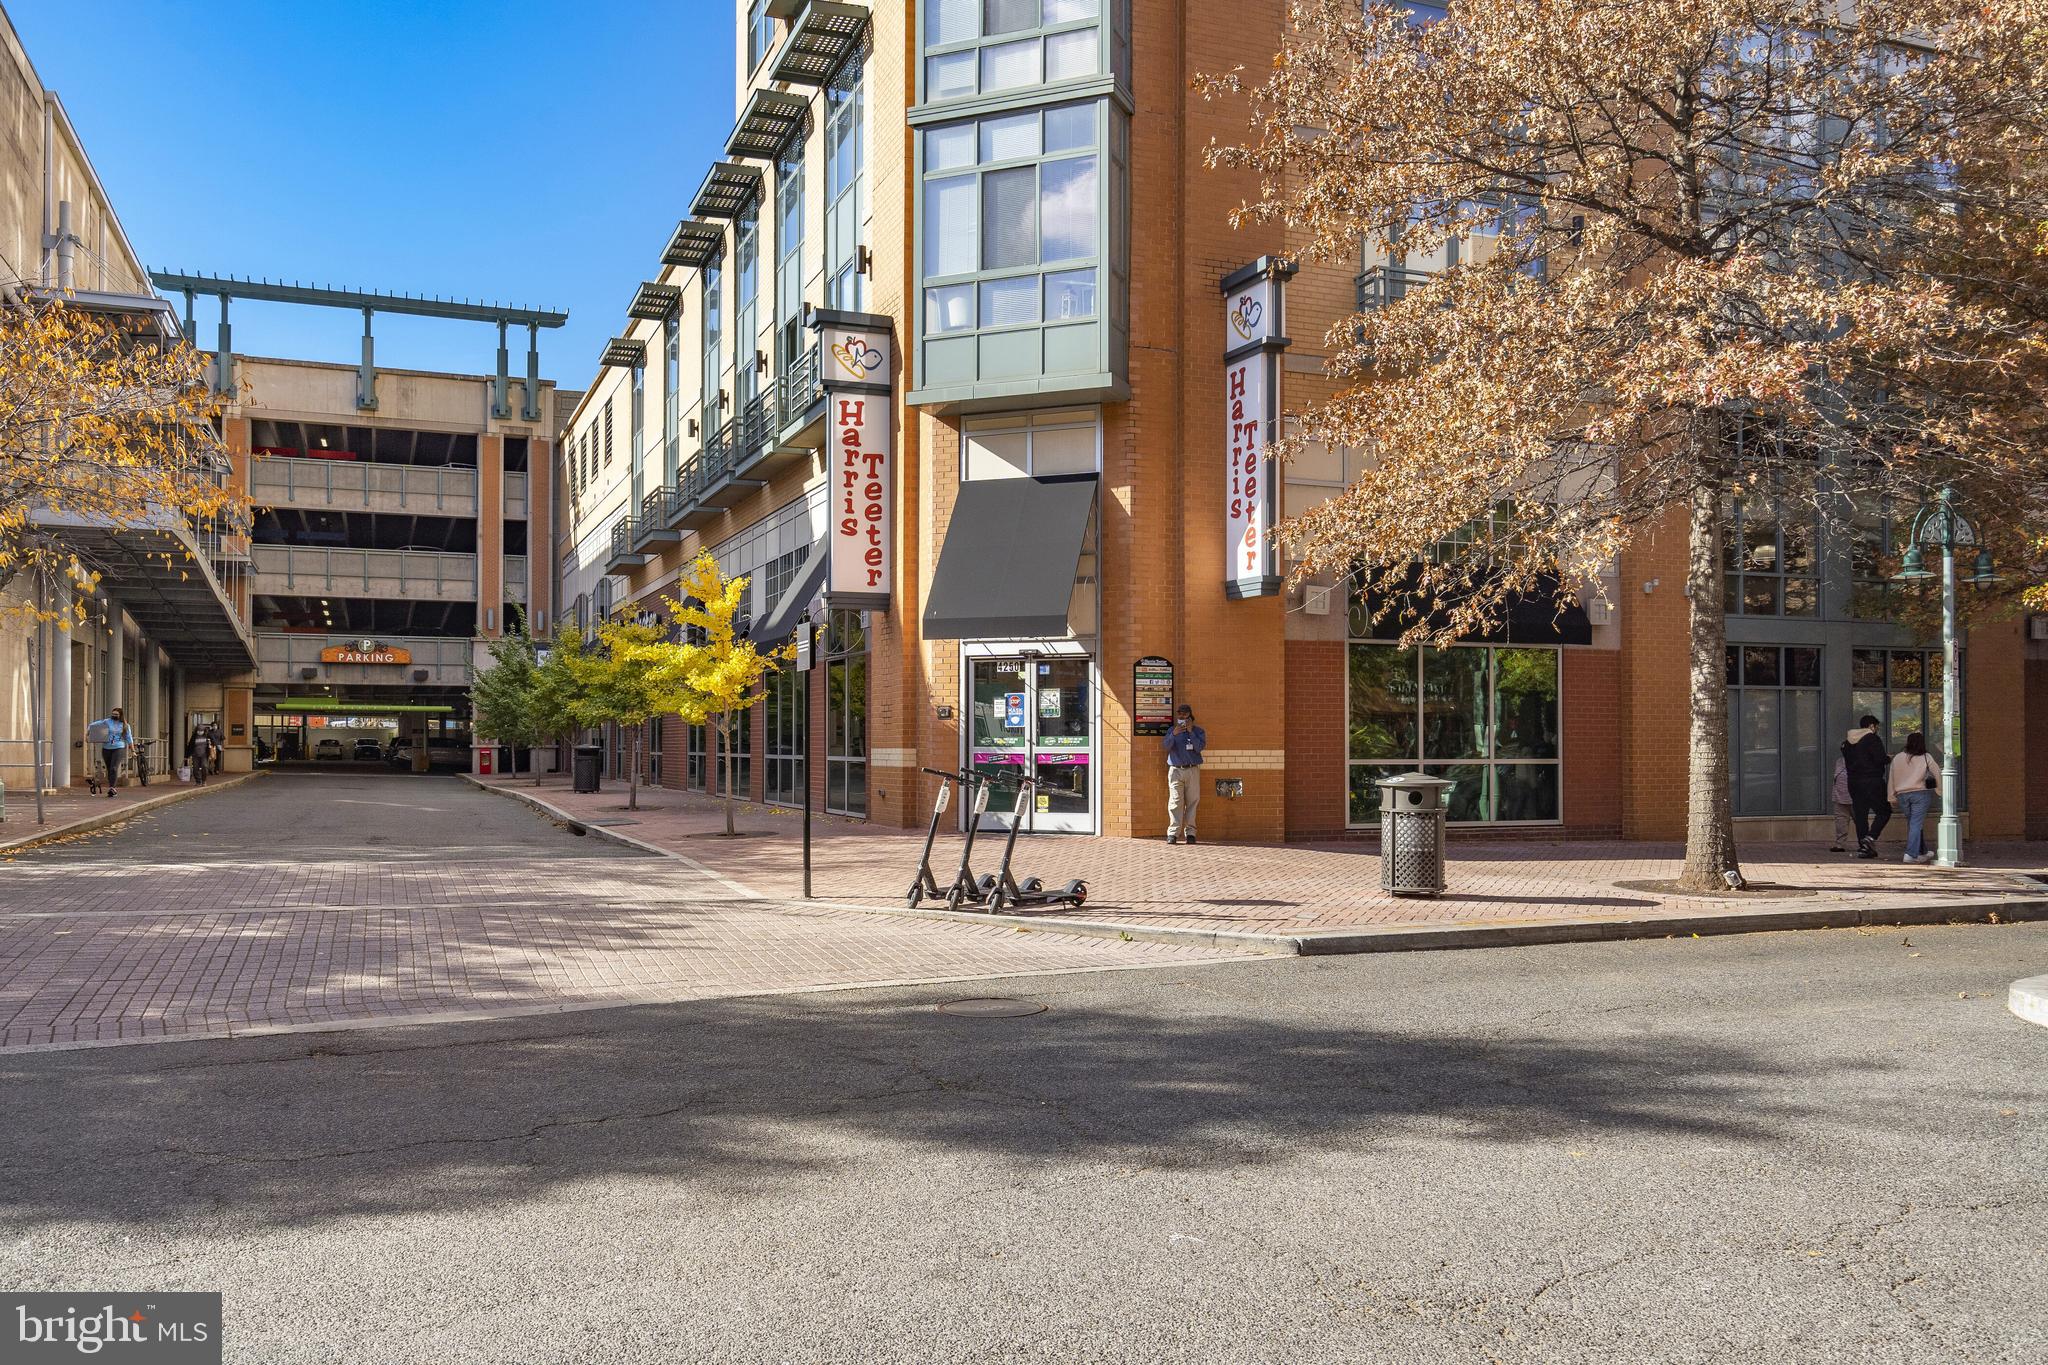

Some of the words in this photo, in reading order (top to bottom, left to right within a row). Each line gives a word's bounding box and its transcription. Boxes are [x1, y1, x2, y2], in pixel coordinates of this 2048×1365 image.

[838, 400, 864, 537] Harris
[1230, 367, 1246, 519] Harris
[1244, 420, 1257, 571] Teeter
[862, 453, 884, 586] Teeter
[338, 653, 394, 662] PARKING
[363, 640, 371, 651] P
[997, 661, 1020, 672] 4250
